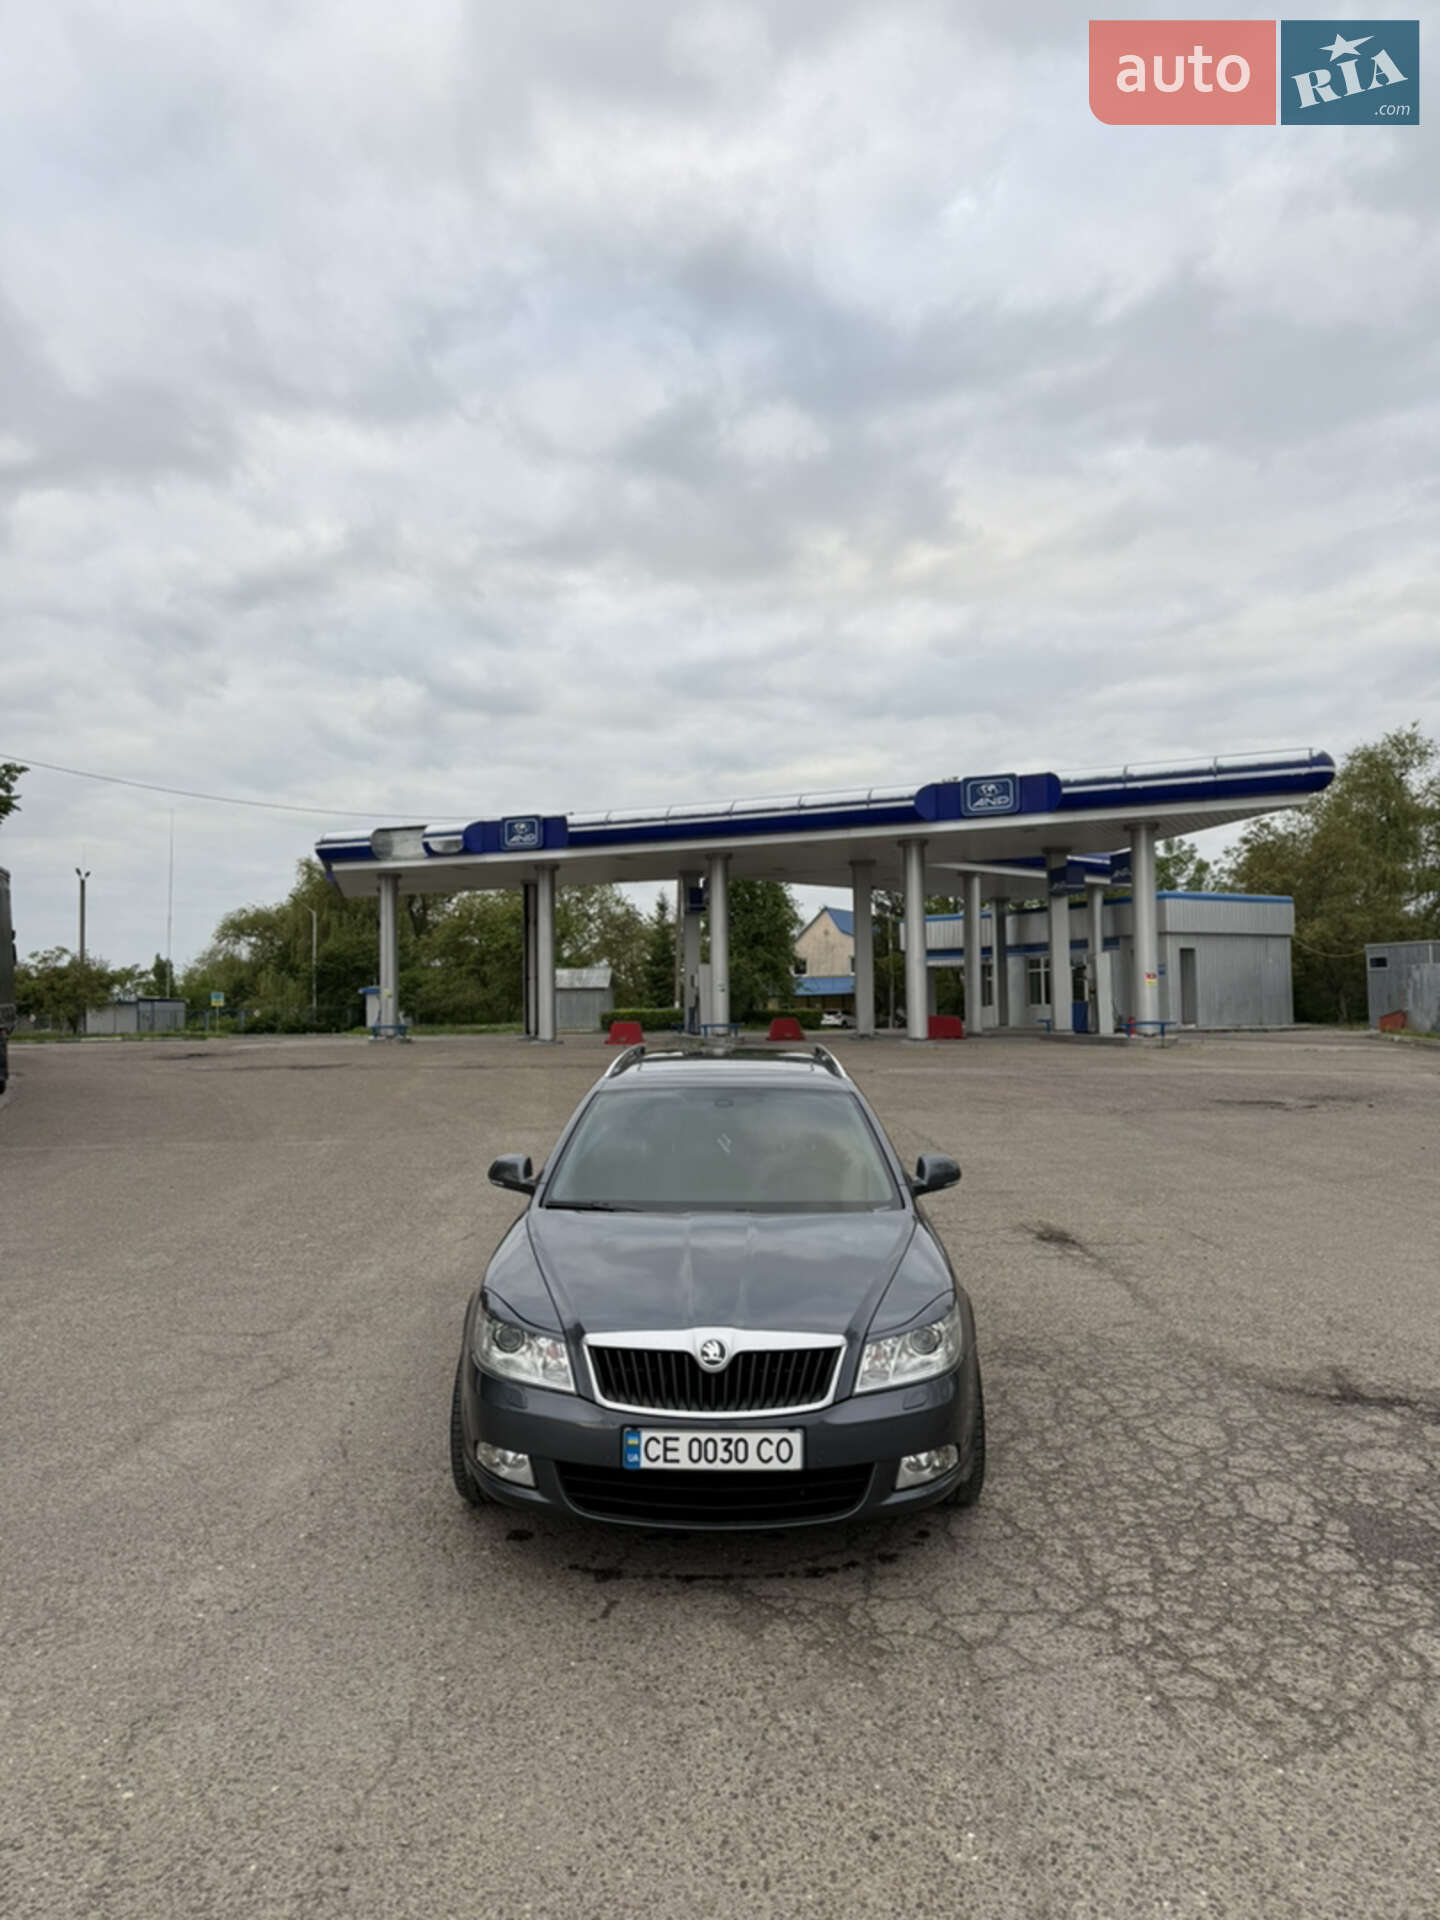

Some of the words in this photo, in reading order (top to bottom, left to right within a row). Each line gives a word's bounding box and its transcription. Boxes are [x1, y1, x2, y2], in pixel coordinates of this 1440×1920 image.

[627, 1454, 639, 1463] UA
[644, 1436, 680, 1464] CE
[688, 1437, 749, 1464] 0030
[756, 1437, 793, 1464] CO
